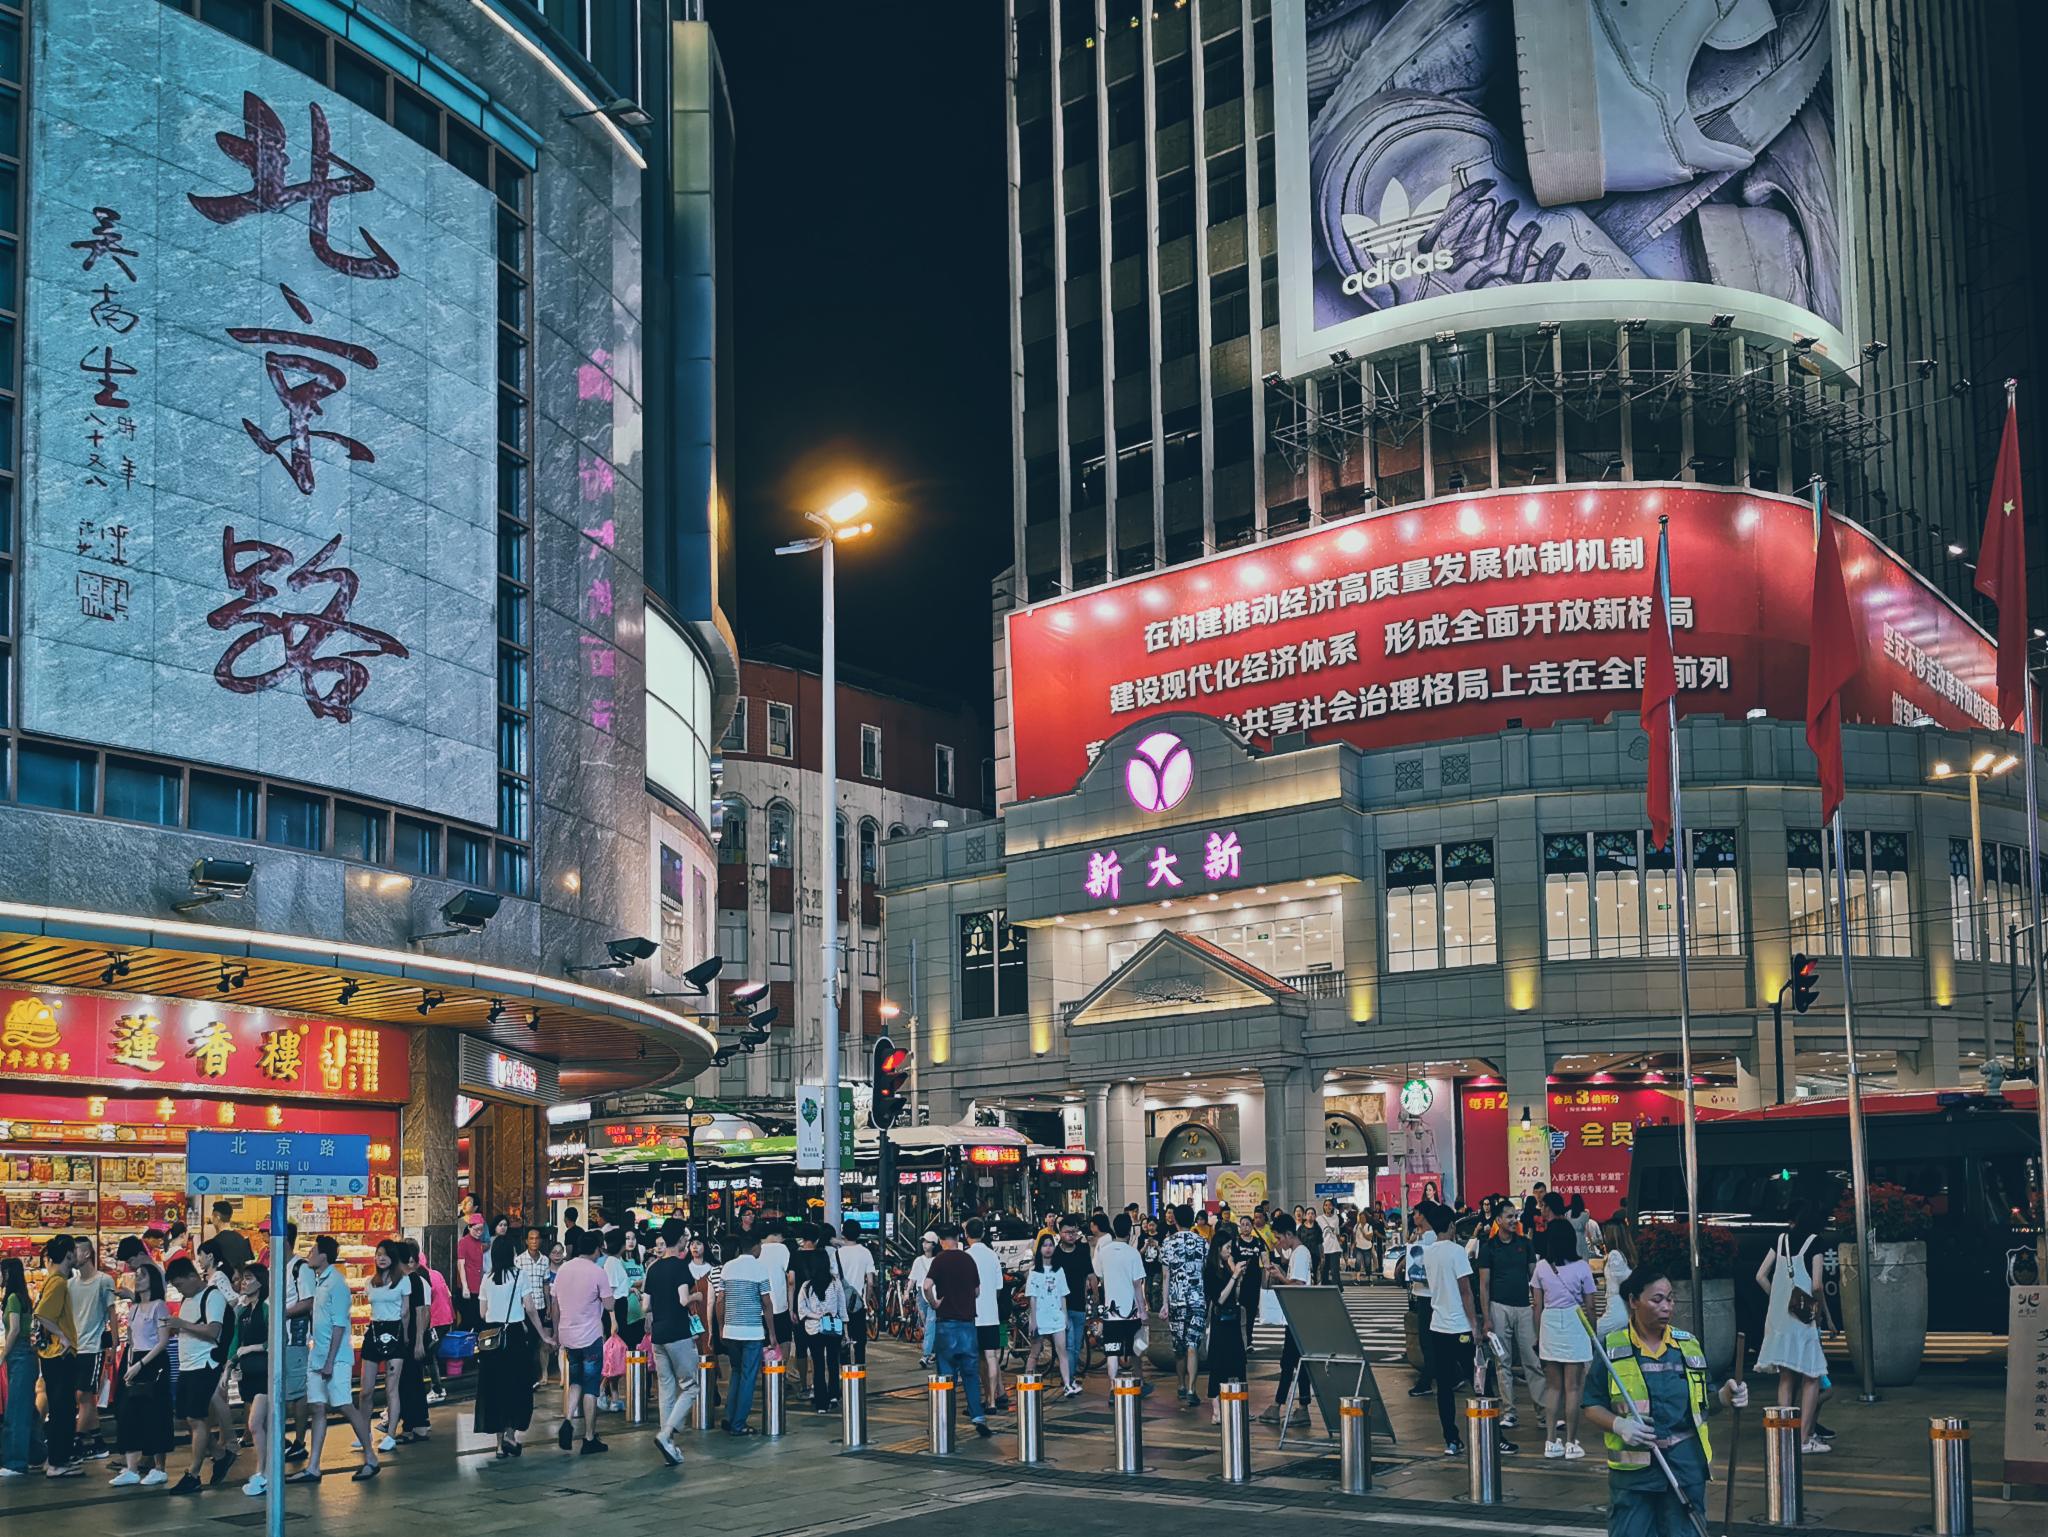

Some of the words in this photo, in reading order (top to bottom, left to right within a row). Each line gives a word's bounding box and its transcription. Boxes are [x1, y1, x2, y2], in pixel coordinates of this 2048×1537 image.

[1342, 247, 1454, 296] adidas
[187, 91, 409, 724] 北京路
[1144, 536, 1643, 653] 在构建推动经济高质量发展体制机制
[1110, 631, 1357, 714] 建设现代化经济体系
[1084, 831, 1242, 900] 新大新
[107, 1011, 303, 1082] 蓮香樓
[230, 1136, 336, 1157] 北京路
[1581, 1121, 1635, 1147] 会员
[219, 1176, 263, 1186] 沿江中路
[255, 1160, 290, 1171] BEIJING
[298, 1160, 309, 1171] LU
